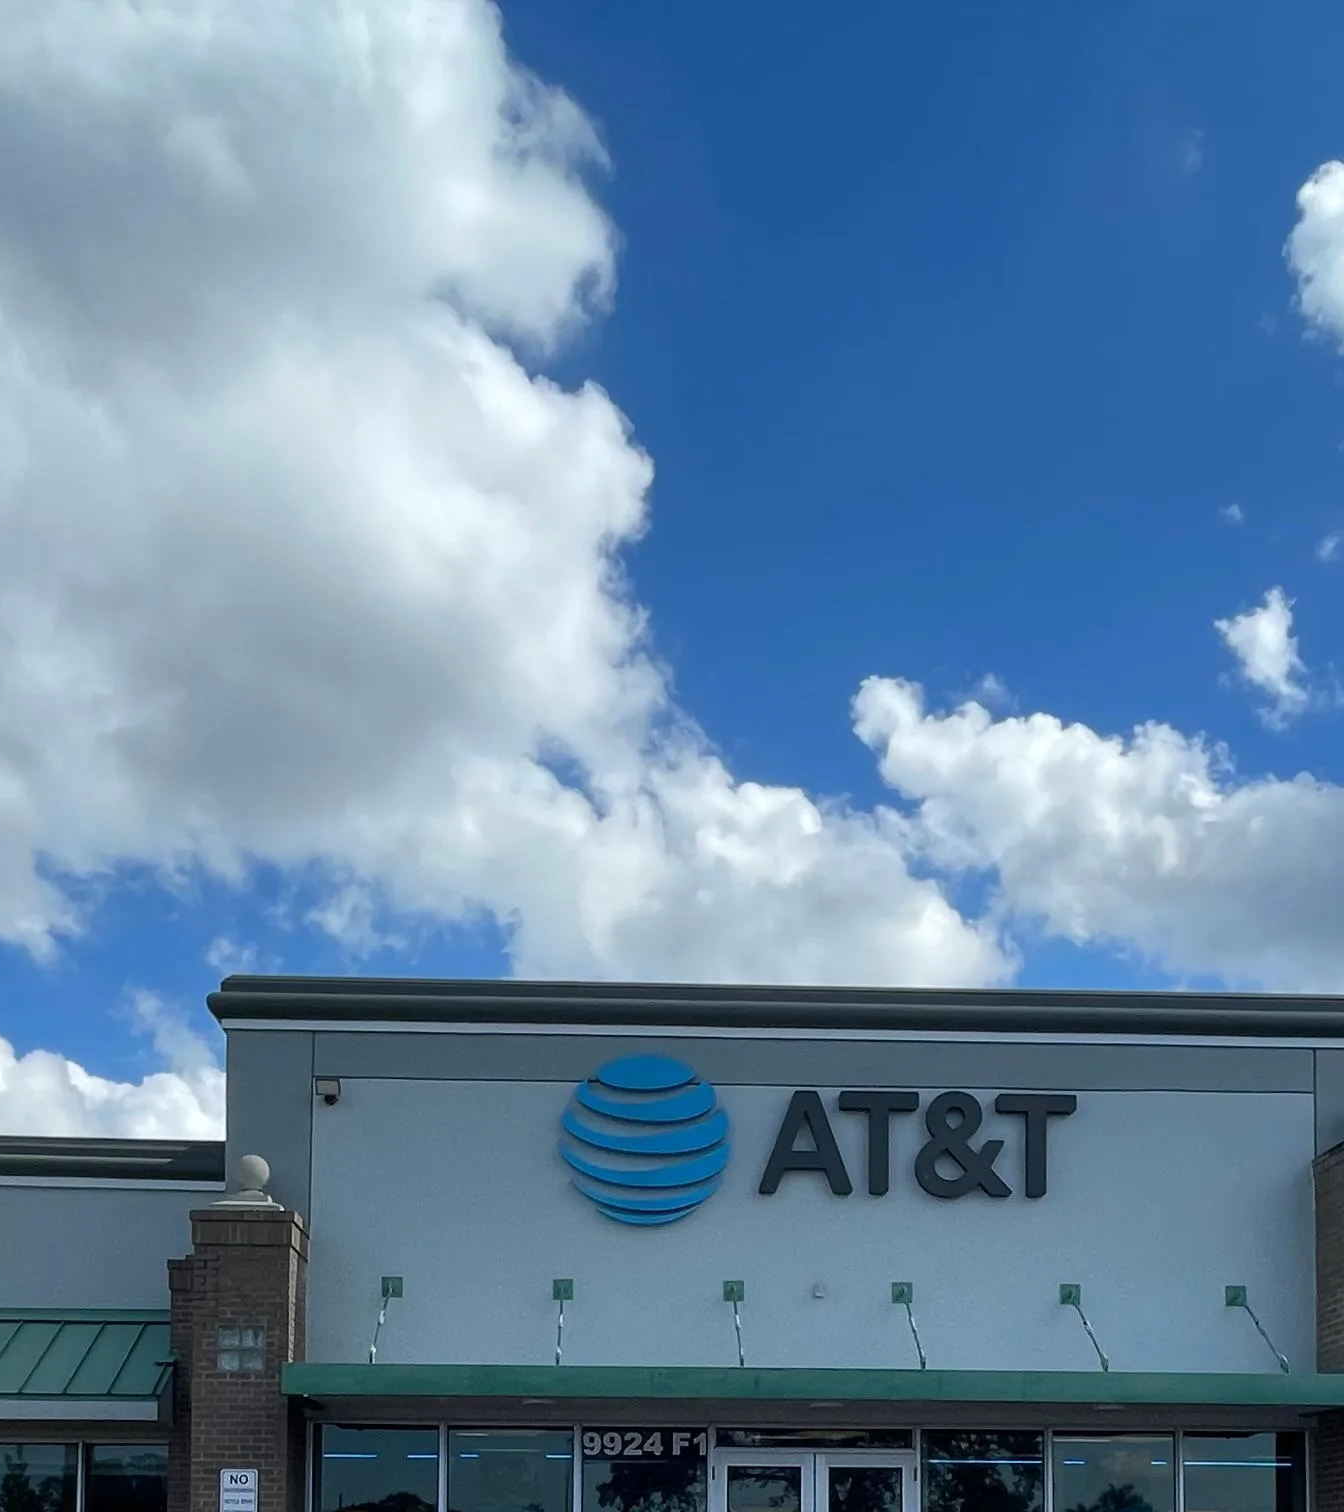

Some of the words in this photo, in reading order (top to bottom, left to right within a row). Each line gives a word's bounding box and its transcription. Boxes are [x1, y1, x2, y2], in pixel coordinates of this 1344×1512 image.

[758, 1090, 1077, 1199] AT&T
[583, 1432, 663, 1455] 9924
[672, 1432, 707, 1456] F1
[229, 1474, 249, 1484] NO
